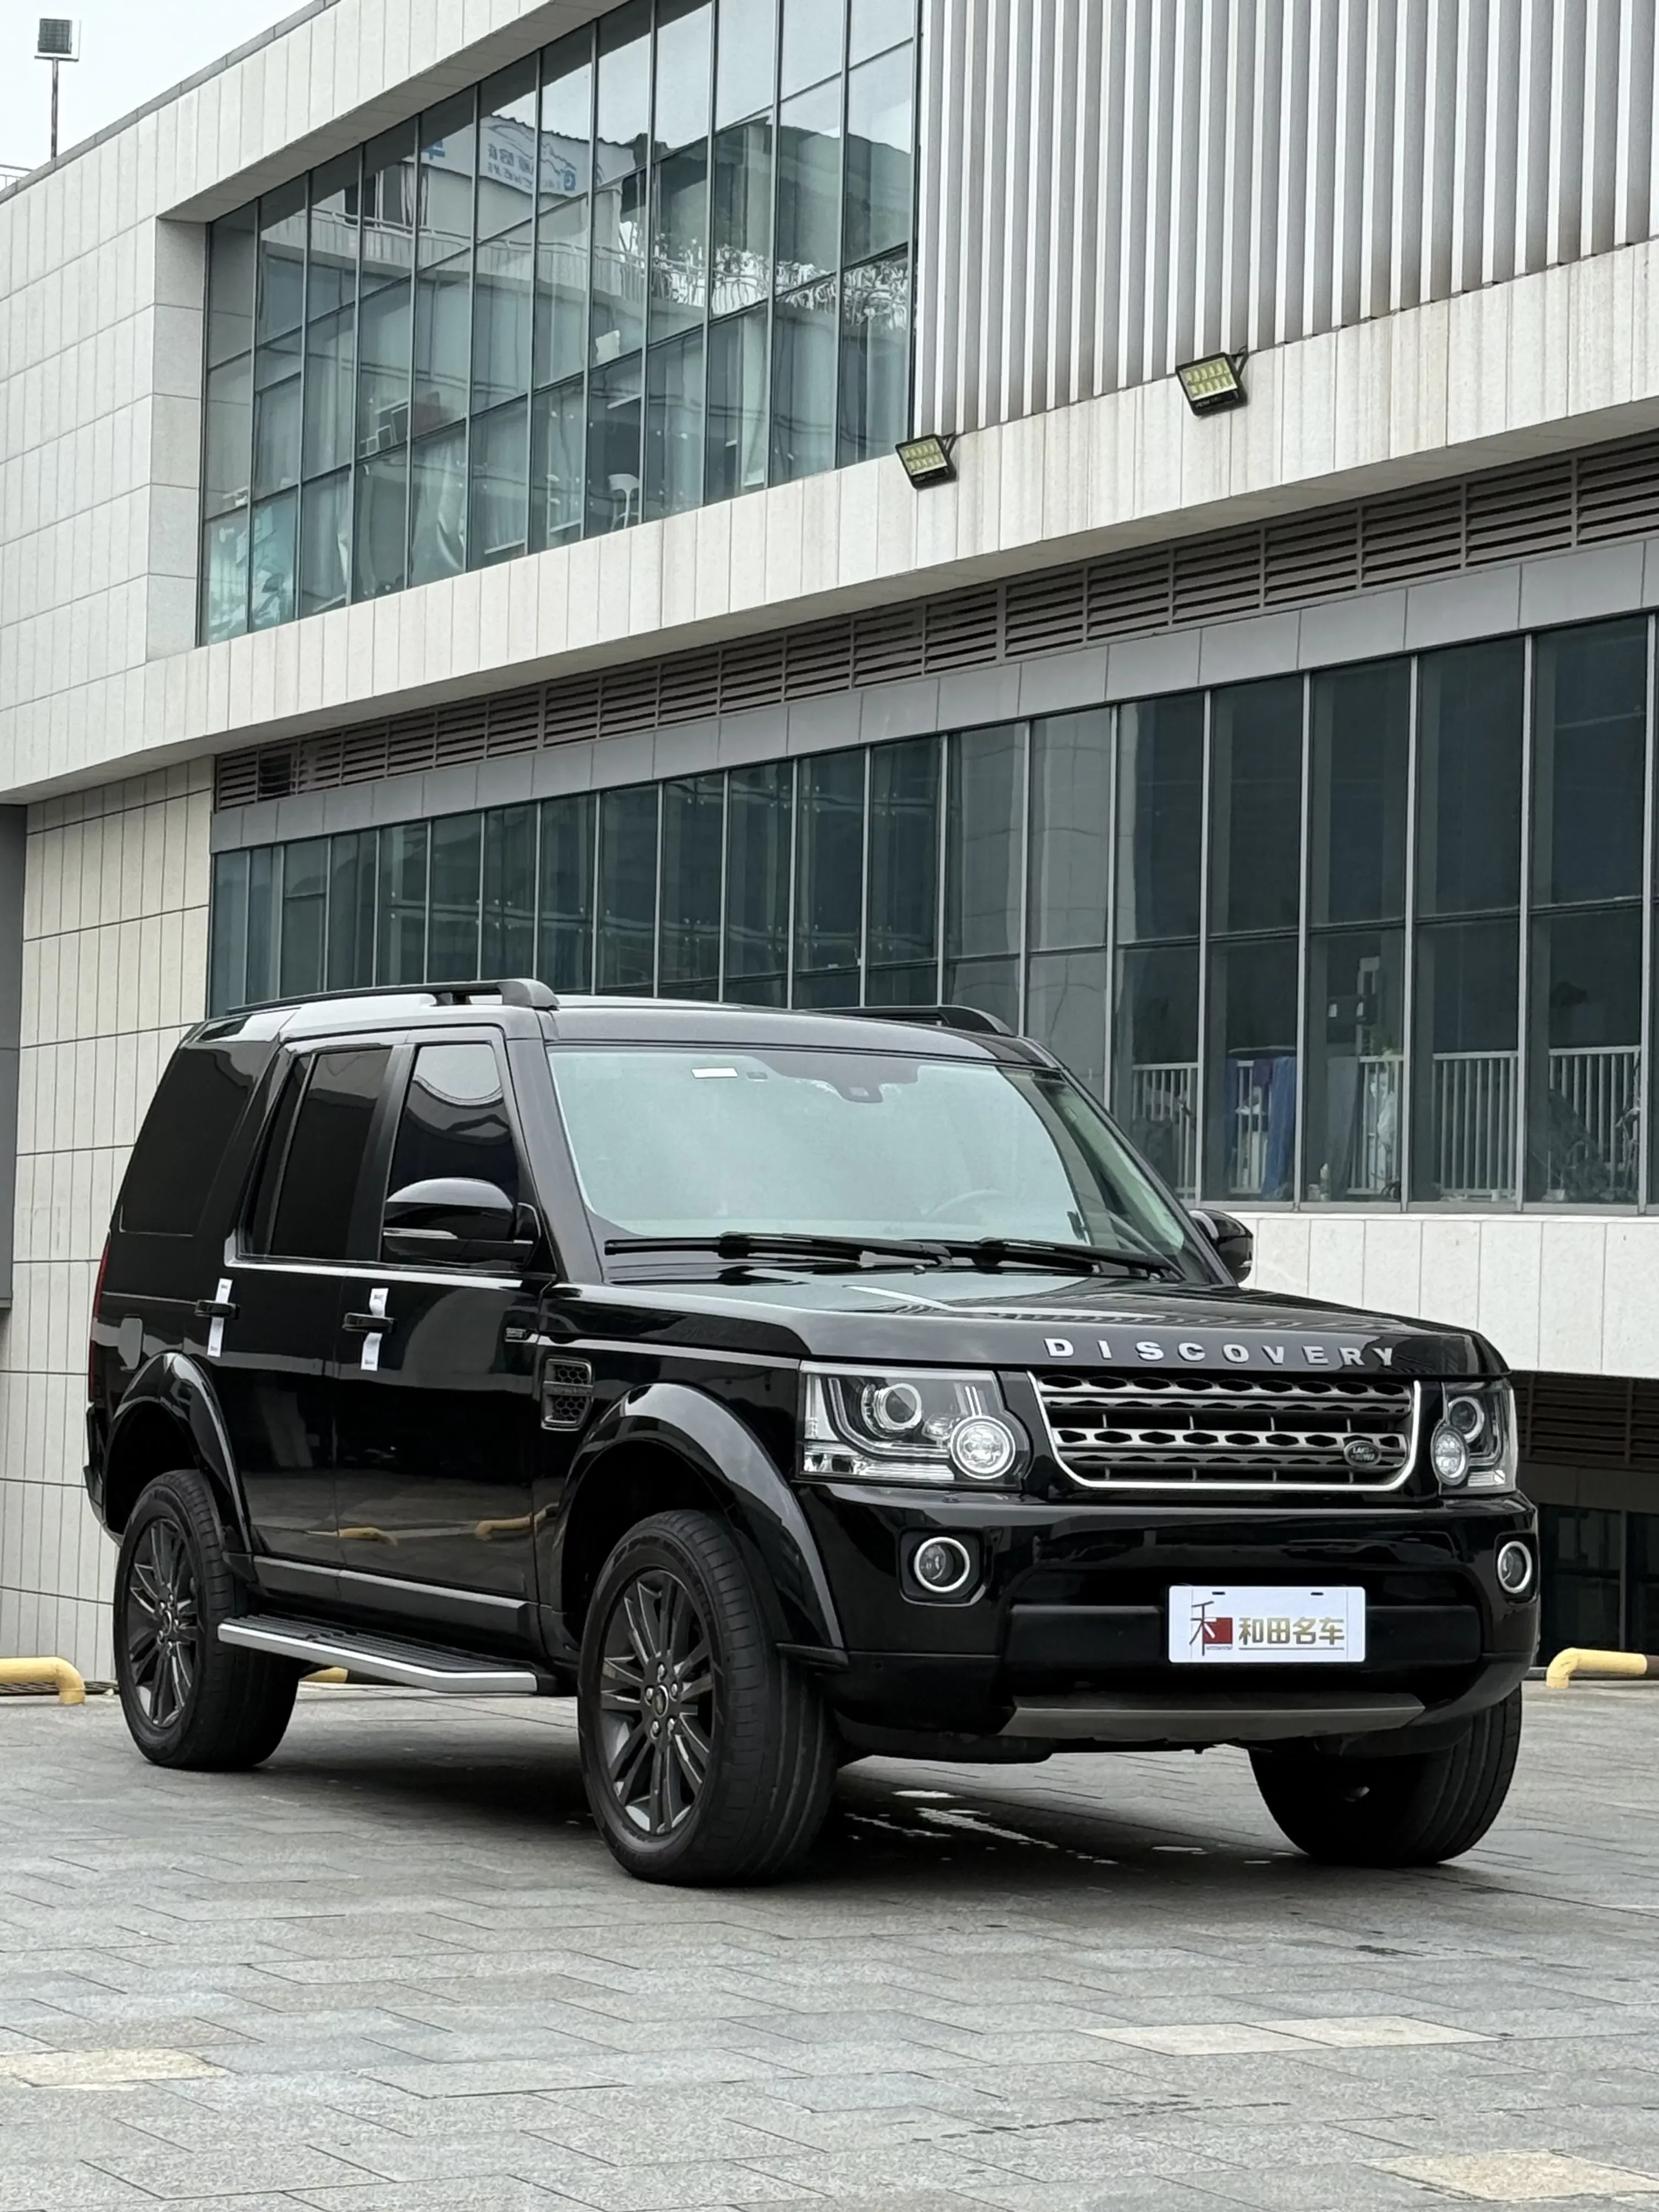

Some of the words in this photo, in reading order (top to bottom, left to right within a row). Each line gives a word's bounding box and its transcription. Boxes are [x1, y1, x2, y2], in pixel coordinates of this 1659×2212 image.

[1043, 1338, 1394, 1366] DISCOVERY
[1238, 1616, 1345, 1645] 和田名车
